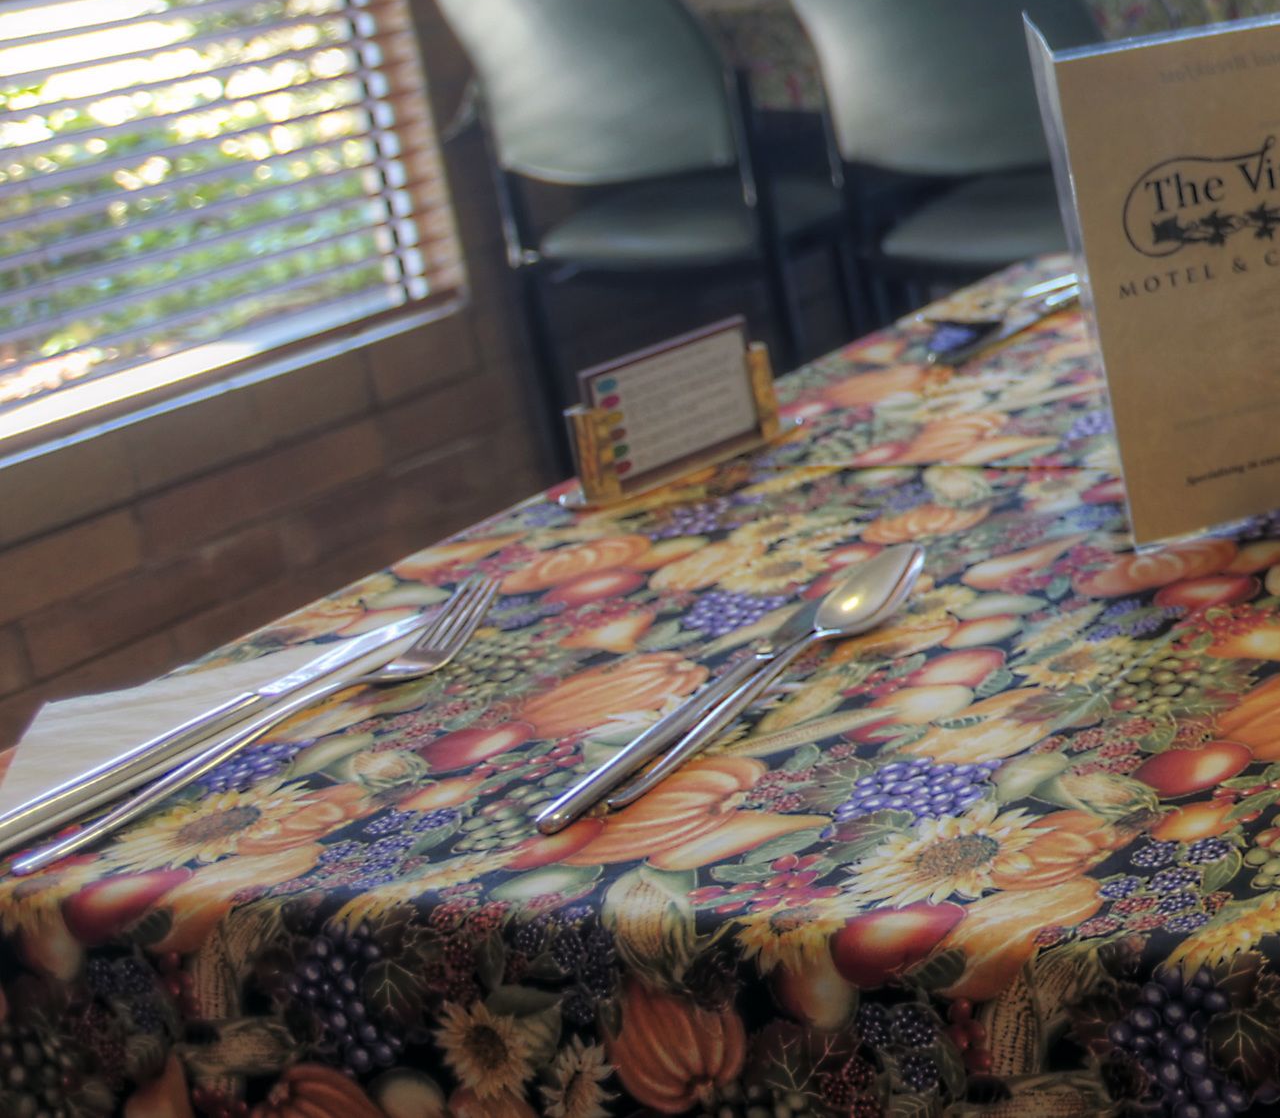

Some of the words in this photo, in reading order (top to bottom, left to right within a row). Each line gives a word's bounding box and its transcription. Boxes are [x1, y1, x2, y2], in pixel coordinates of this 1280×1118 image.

[1145, 169, 1225, 213] The
[1119, 262, 1215, 300] MOTEL
[1232, 257, 1248, 274] &
